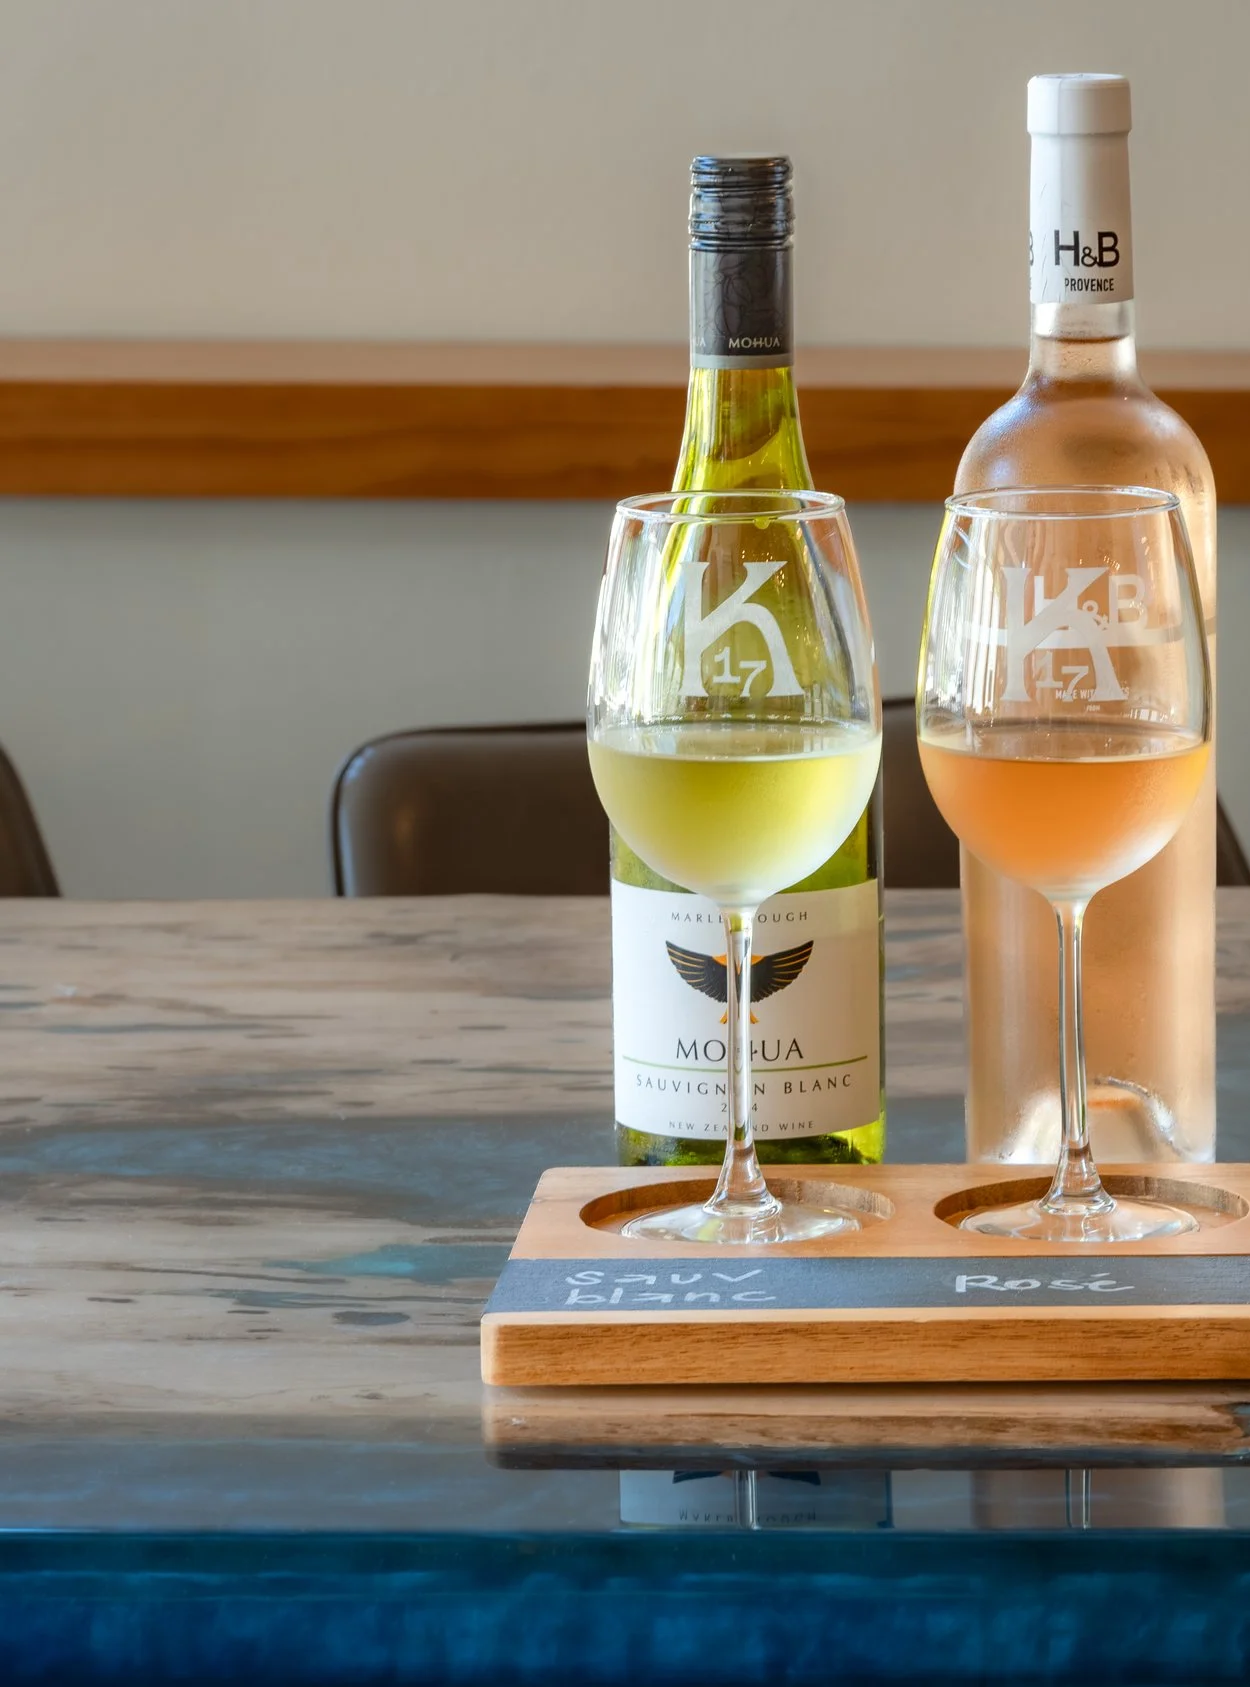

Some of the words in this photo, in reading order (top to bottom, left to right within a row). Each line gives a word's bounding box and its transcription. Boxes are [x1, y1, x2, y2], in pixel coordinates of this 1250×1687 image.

[1054, 229, 1120, 267] H&B
[1065, 278, 1115, 292] PROVENCE
[728, 337, 780, 349] MOHUA
[678, 561, 806, 697] K
[1000, 567, 1128, 701] K
[712, 646, 768, 697] 17
[1036, 651, 1089, 701] 17
[636, 1074, 765, 1096] SAUVIGNN
[784, 1073, 851, 1095] BLANC
[721, 1103, 758, 1113] 24
[669, 1121, 695, 1131] NEW
[704, 1123, 769, 1132] ZEAND
[778, 1120, 815, 1131] WINE
[955, 1272, 1135, 1293] Rosé
